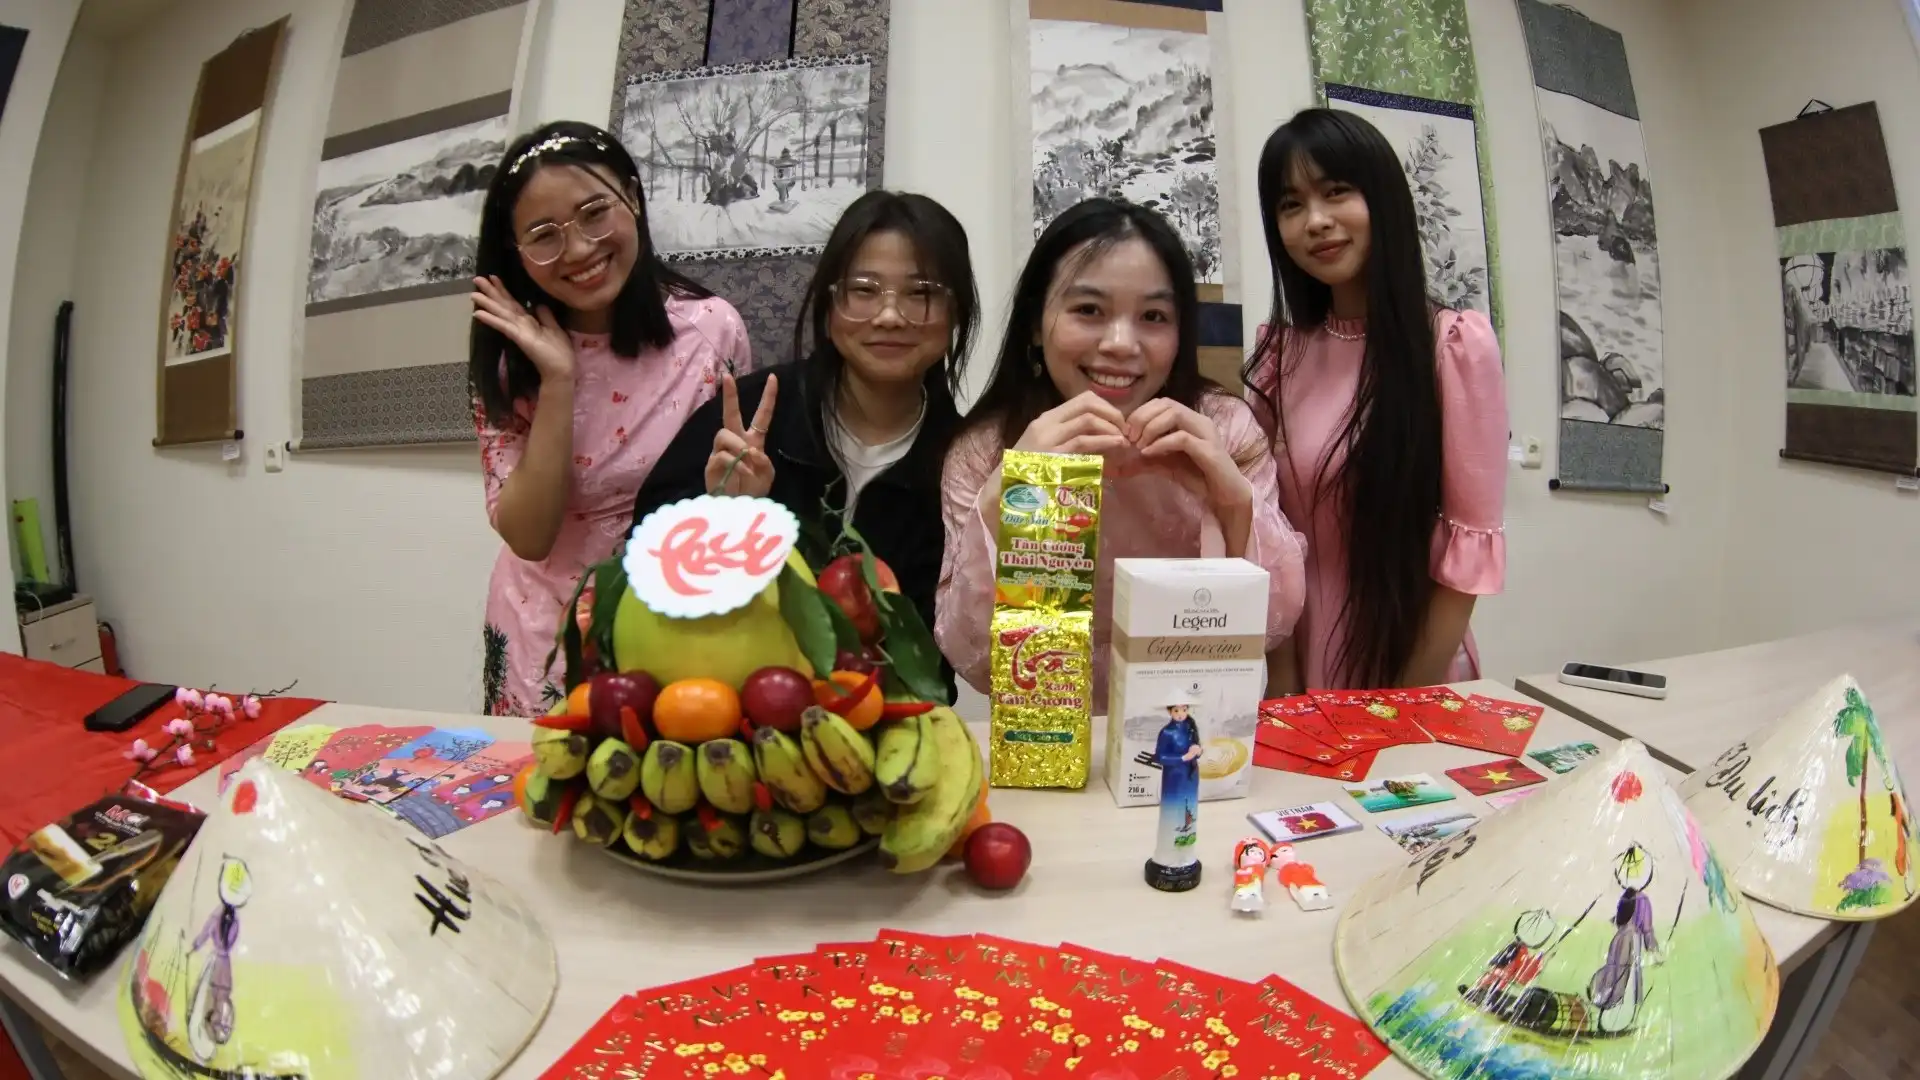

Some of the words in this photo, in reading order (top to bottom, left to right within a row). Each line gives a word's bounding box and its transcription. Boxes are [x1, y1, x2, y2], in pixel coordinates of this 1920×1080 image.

[1173, 613, 1227, 631] Legend
[1147, 637, 1242, 661] Cappuccino
[1277, 805, 1316, 817] VIETNAM
